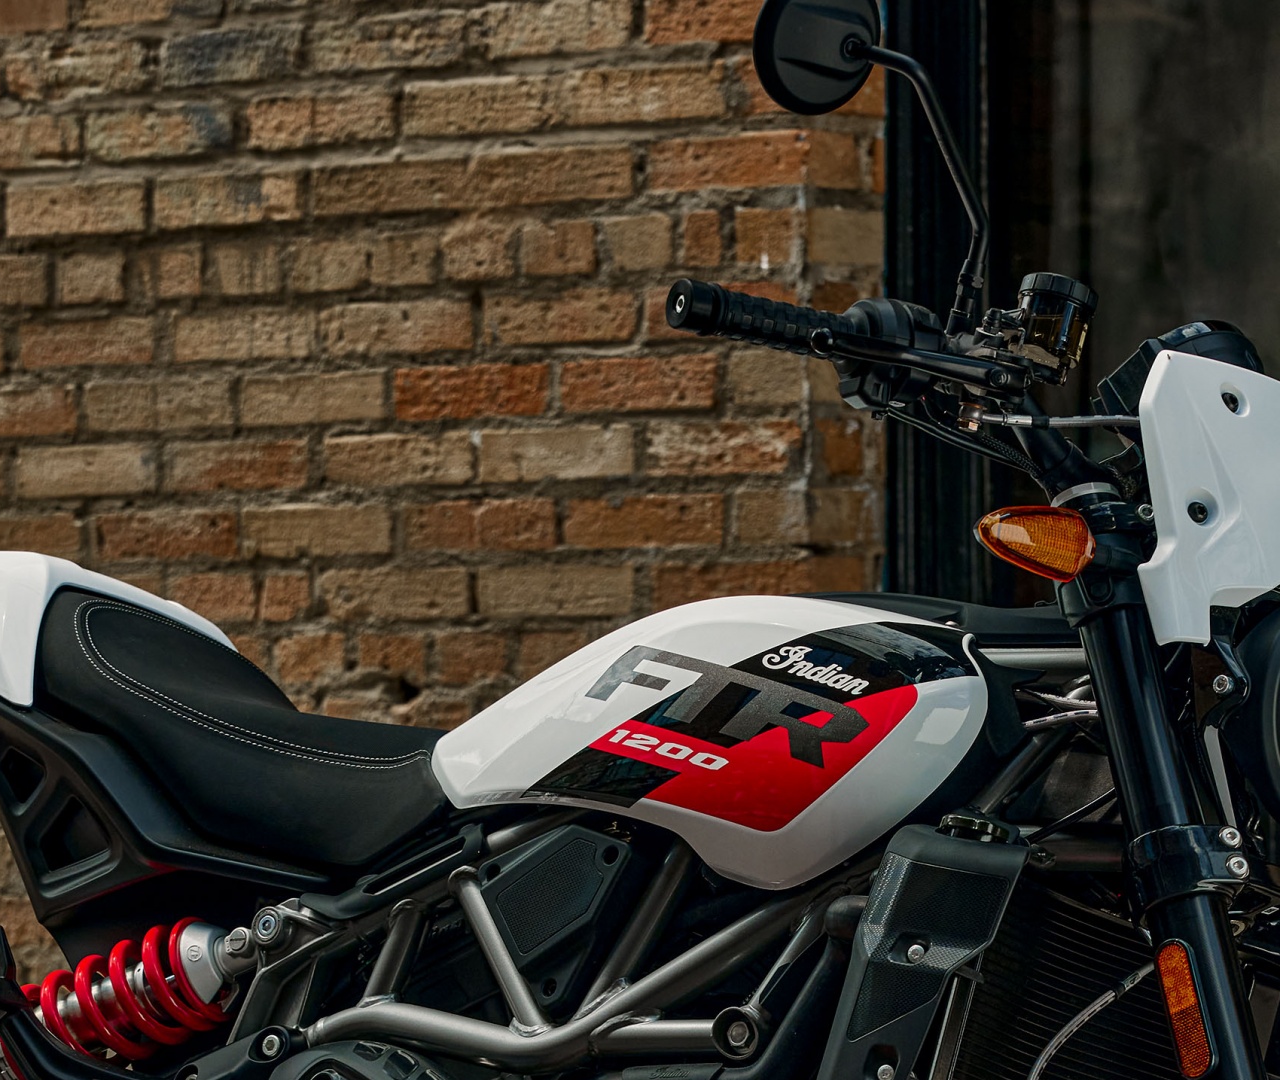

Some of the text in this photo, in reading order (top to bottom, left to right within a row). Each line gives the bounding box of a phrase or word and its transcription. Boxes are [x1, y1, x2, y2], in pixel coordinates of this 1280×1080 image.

[761, 645, 870, 695] Indian
[584, 645, 870, 769] FTR
[608, 729, 729, 771] 1200
